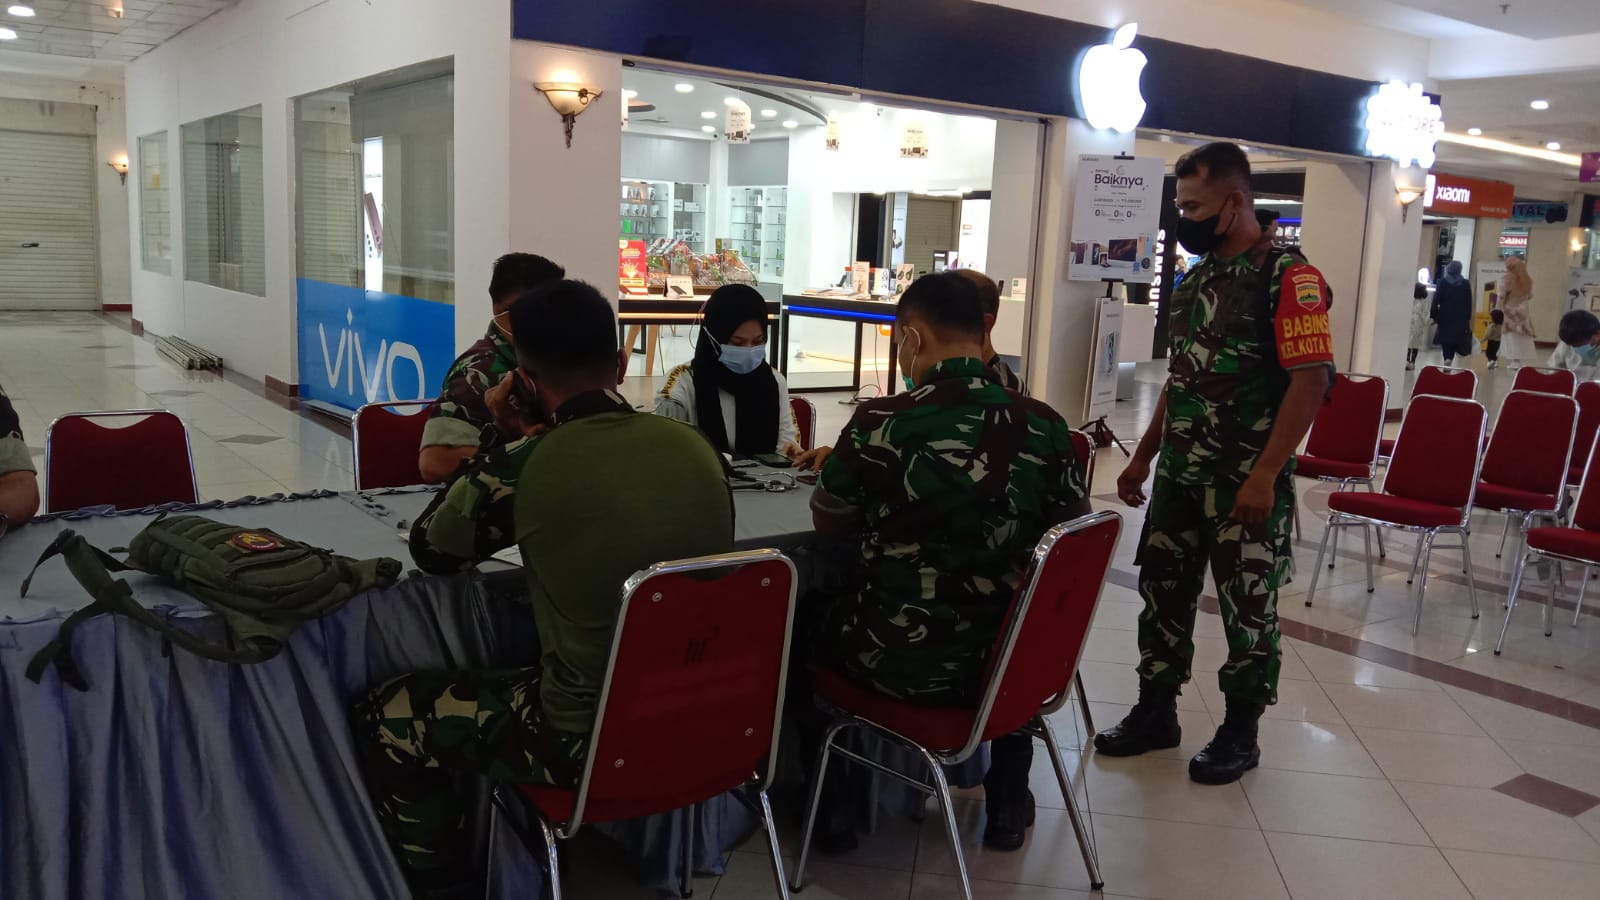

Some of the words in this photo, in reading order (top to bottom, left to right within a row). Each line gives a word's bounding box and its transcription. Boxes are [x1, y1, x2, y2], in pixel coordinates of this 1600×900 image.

[1094, 173, 1144, 189] Baiknya
[1435, 186, 1470, 203] xiaomi
[319, 307, 425, 416] vivo
